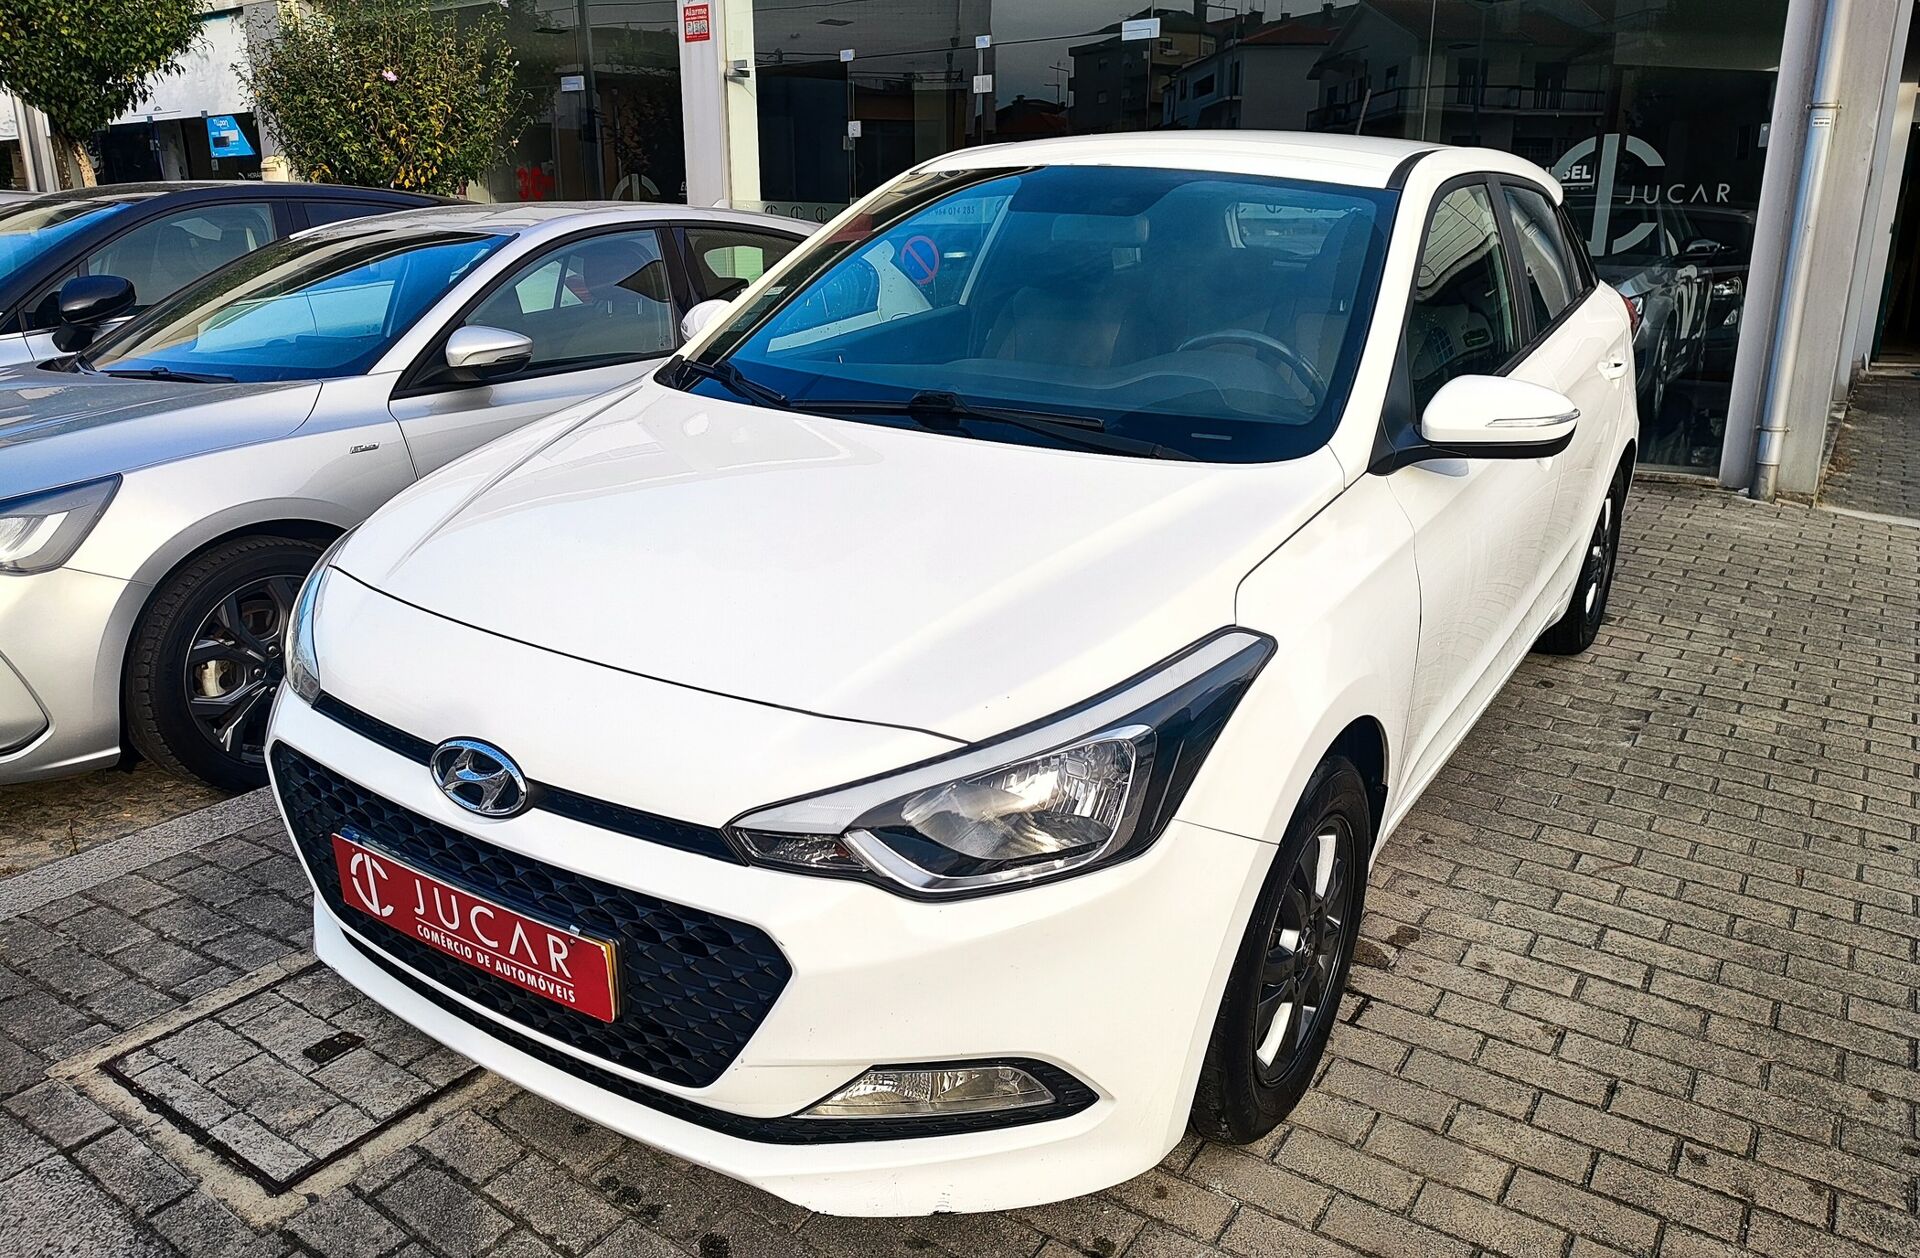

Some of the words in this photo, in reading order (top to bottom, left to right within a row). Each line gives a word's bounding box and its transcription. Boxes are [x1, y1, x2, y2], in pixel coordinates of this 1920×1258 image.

[1625, 183, 1731, 205] JUCAR
[413, 878, 572, 979] JUCAR
[416, 923, 473, 960] COMÉRCIO
[476, 950, 491, 968] DE
[495, 959, 576, 1003] AUTOMÓVEIS
